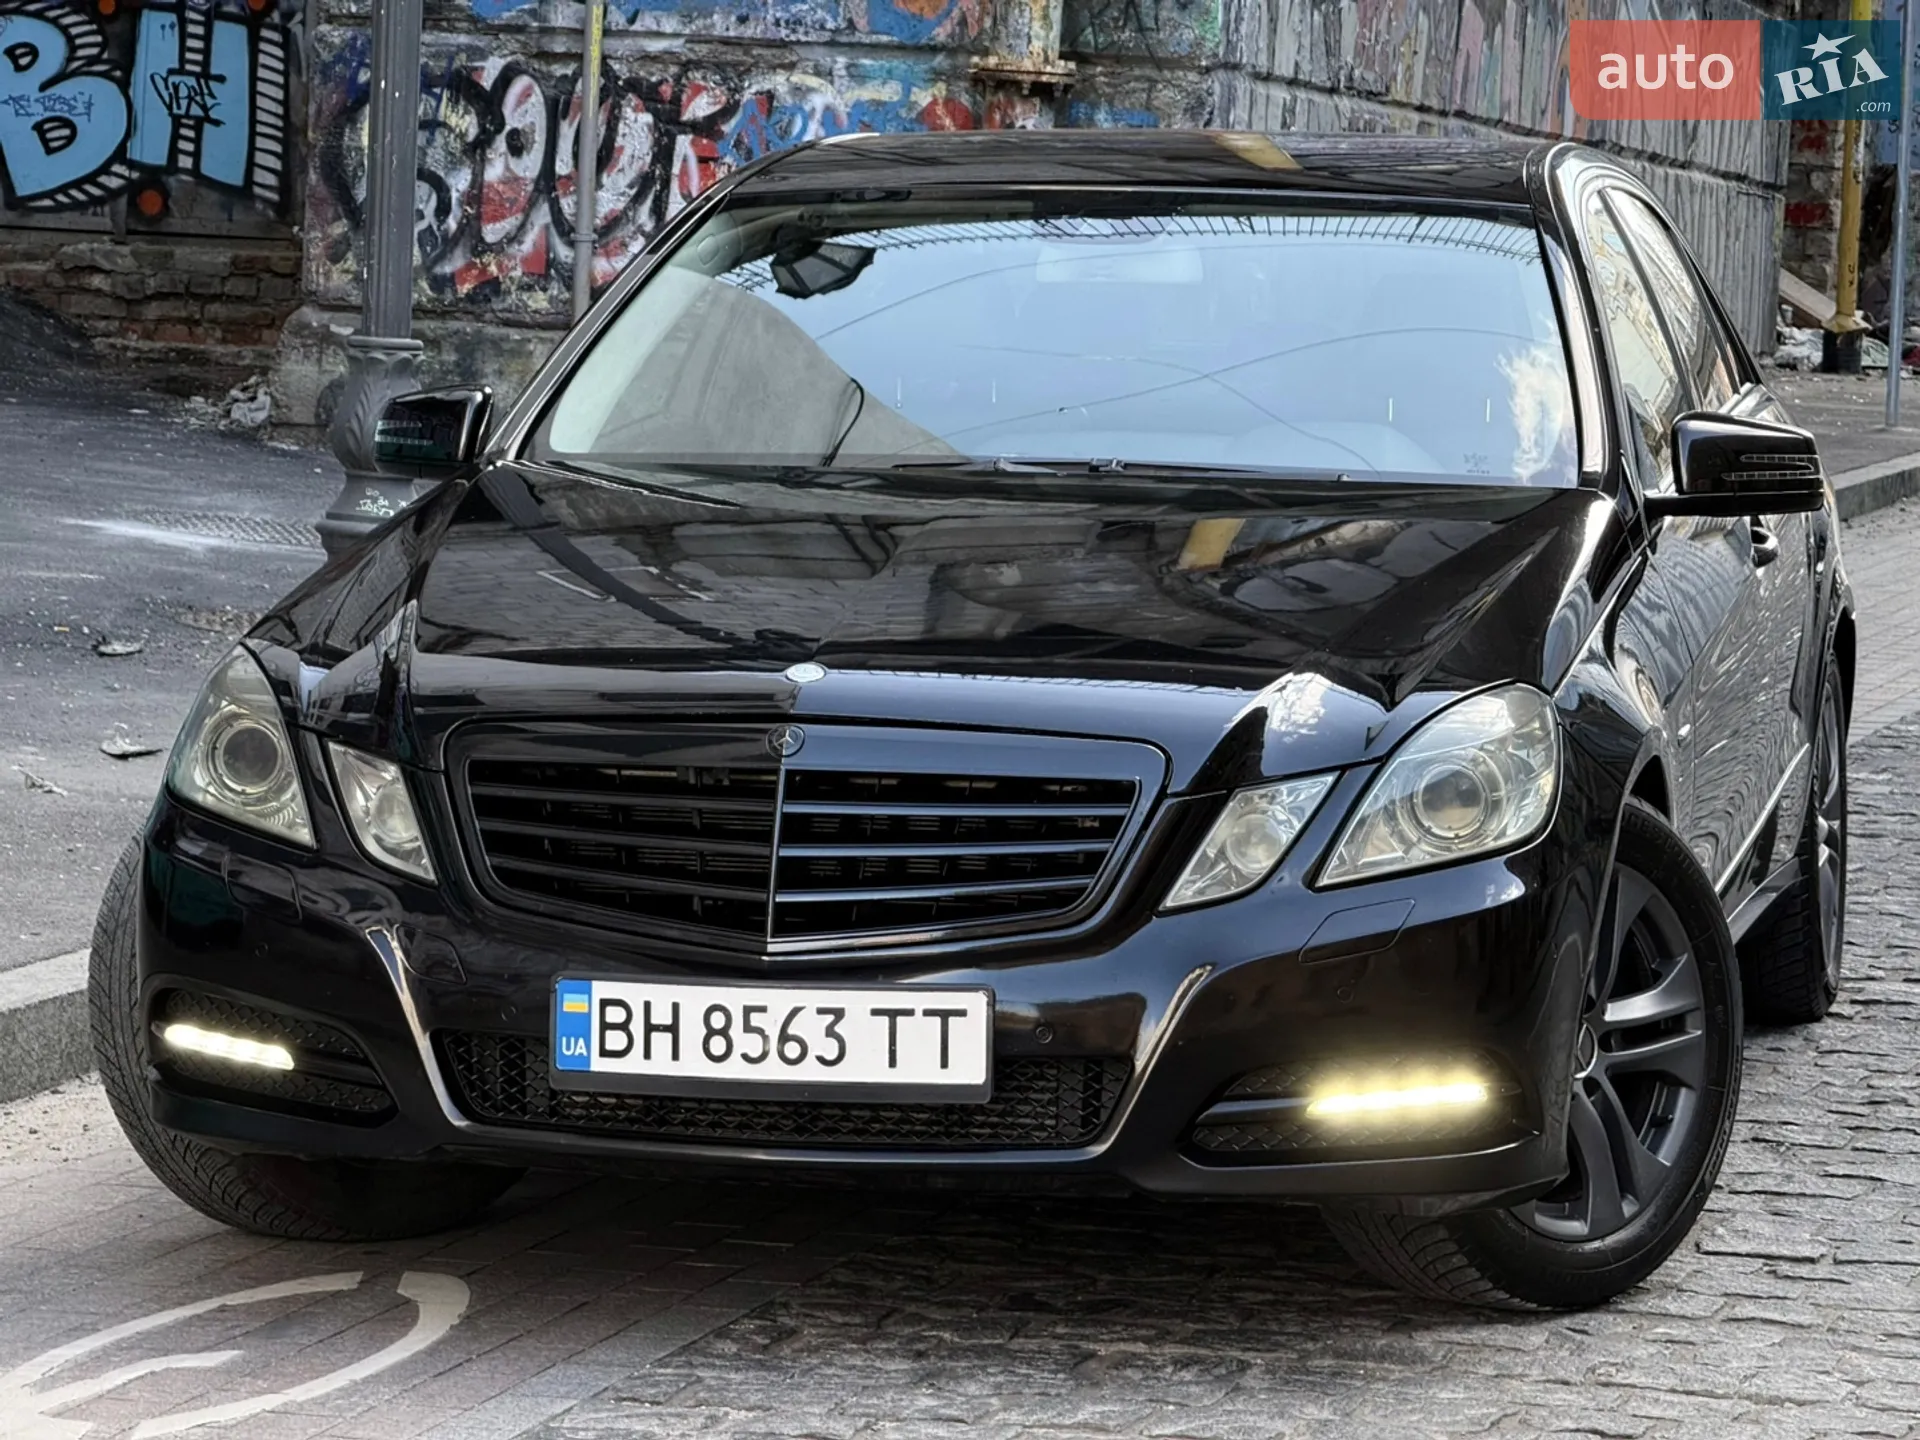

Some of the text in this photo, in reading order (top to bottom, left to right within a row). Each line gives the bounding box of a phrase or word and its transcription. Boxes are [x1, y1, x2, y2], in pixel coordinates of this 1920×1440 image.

[562, 1037, 588, 1057] UA
[598, 998, 968, 1069] BH 8563 TT
